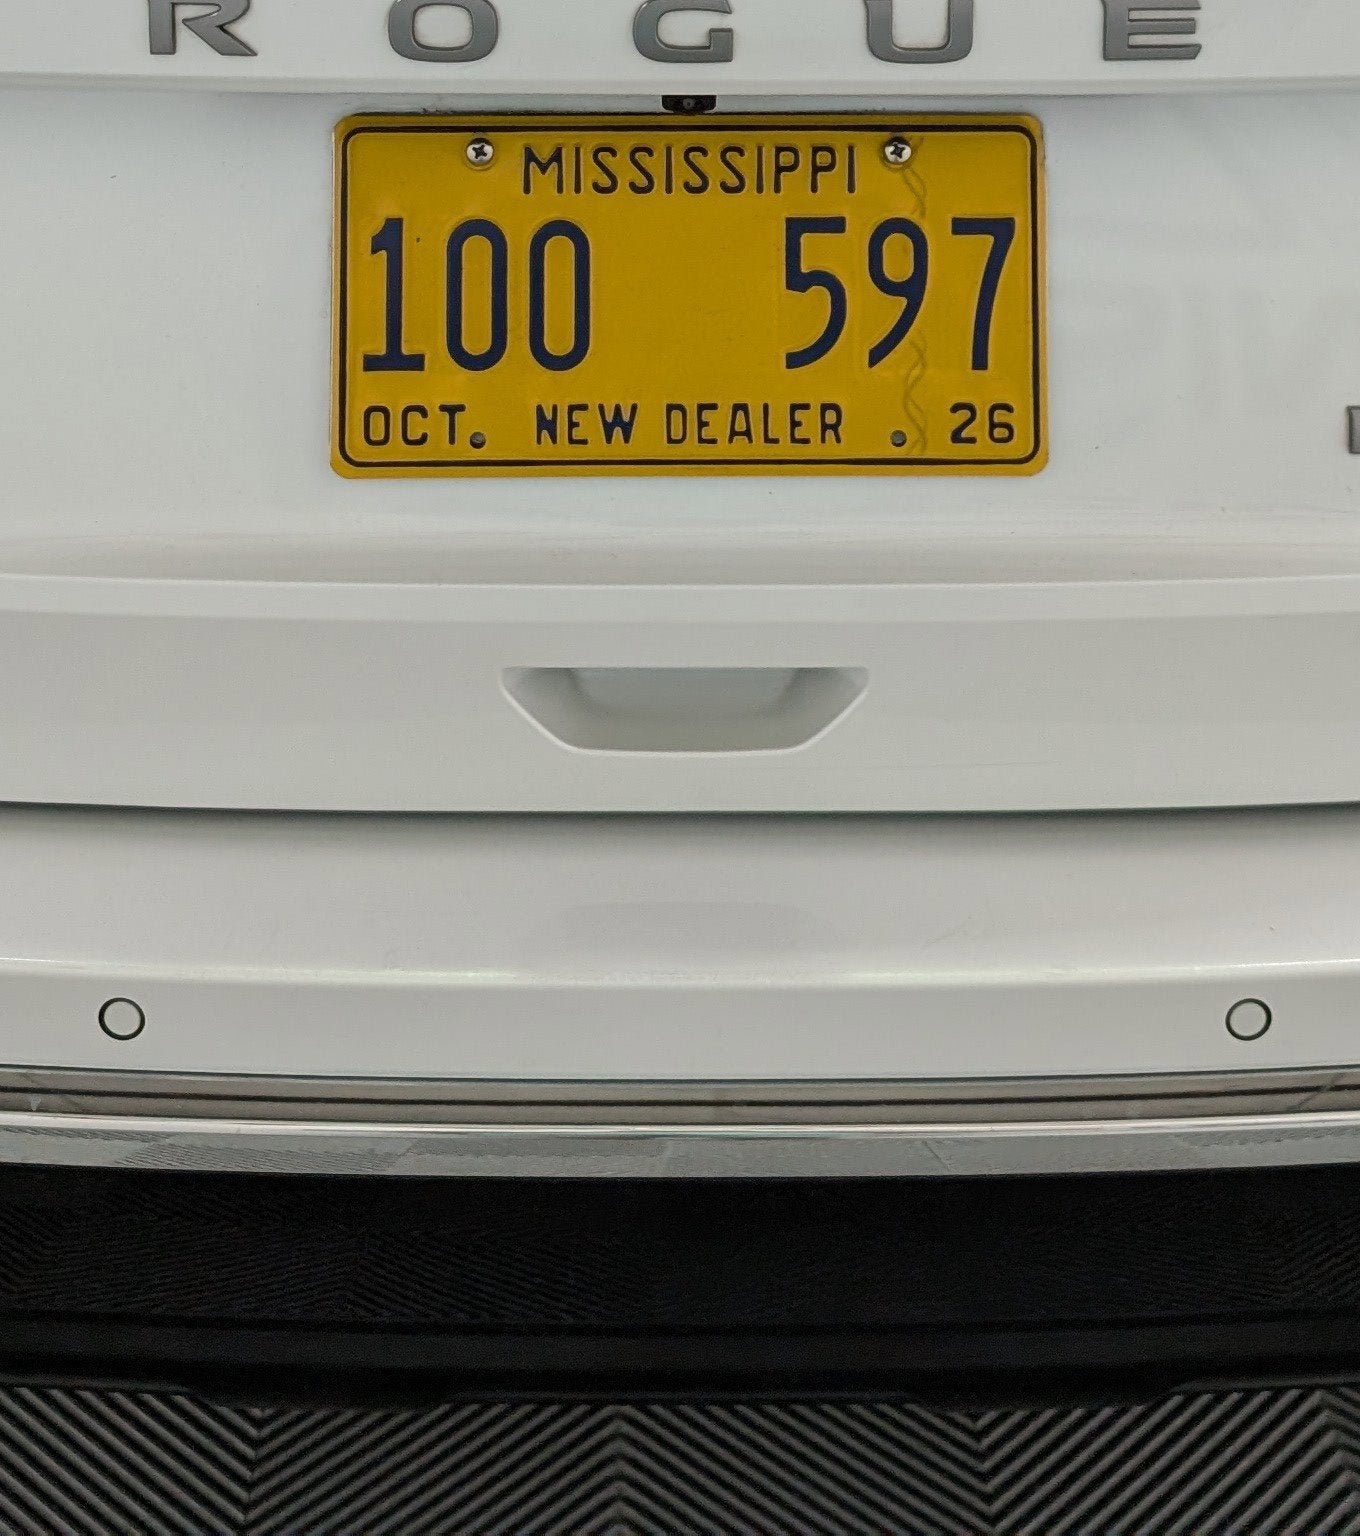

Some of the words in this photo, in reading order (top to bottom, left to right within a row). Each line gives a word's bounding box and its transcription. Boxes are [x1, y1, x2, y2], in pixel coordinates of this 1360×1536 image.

[521, 145, 858, 195] MISSISSIPPI
[362, 216, 591, 372] 100
[784, 216, 1016, 371] 597
[536, 402, 638, 444] NEW
[664, 402, 843, 444] DEALER
[949, 401, 1016, 445] 26
